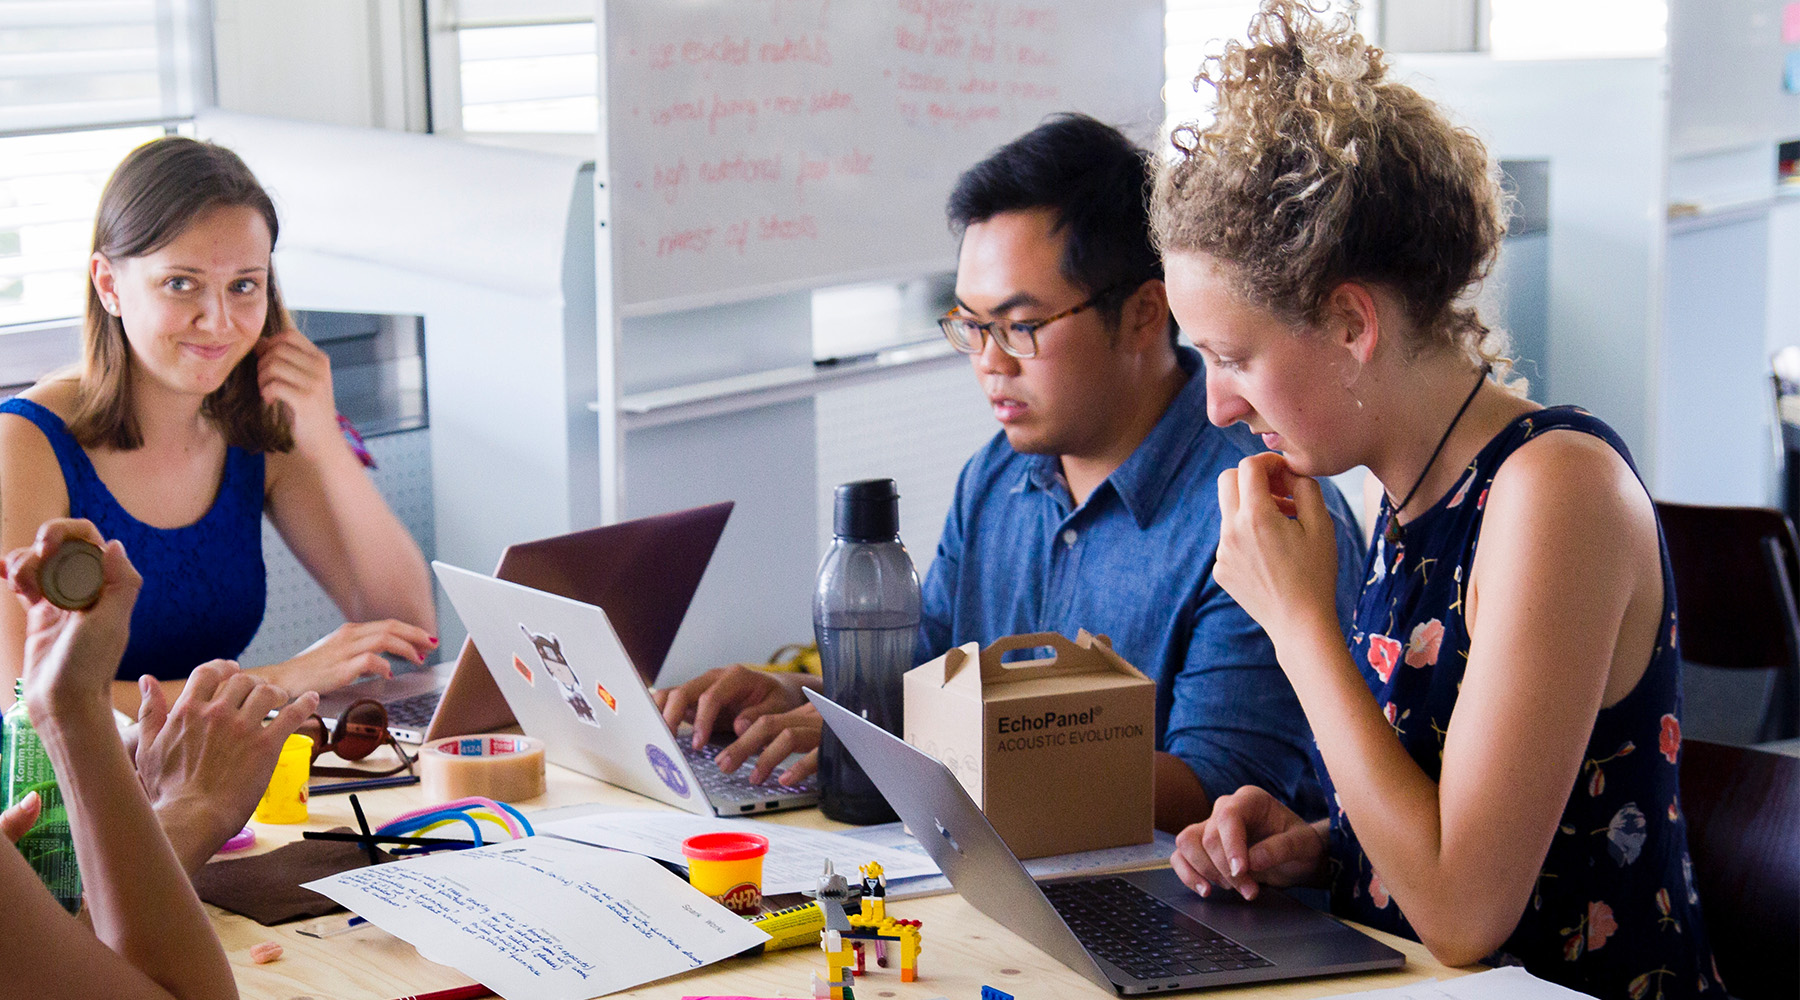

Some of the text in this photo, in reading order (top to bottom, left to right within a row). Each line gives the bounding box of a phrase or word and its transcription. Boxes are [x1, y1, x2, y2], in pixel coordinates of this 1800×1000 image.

[997, 724, 1144, 753] ACOUSTIC EVOLUTION
[16, 748, 26, 782] Komm
